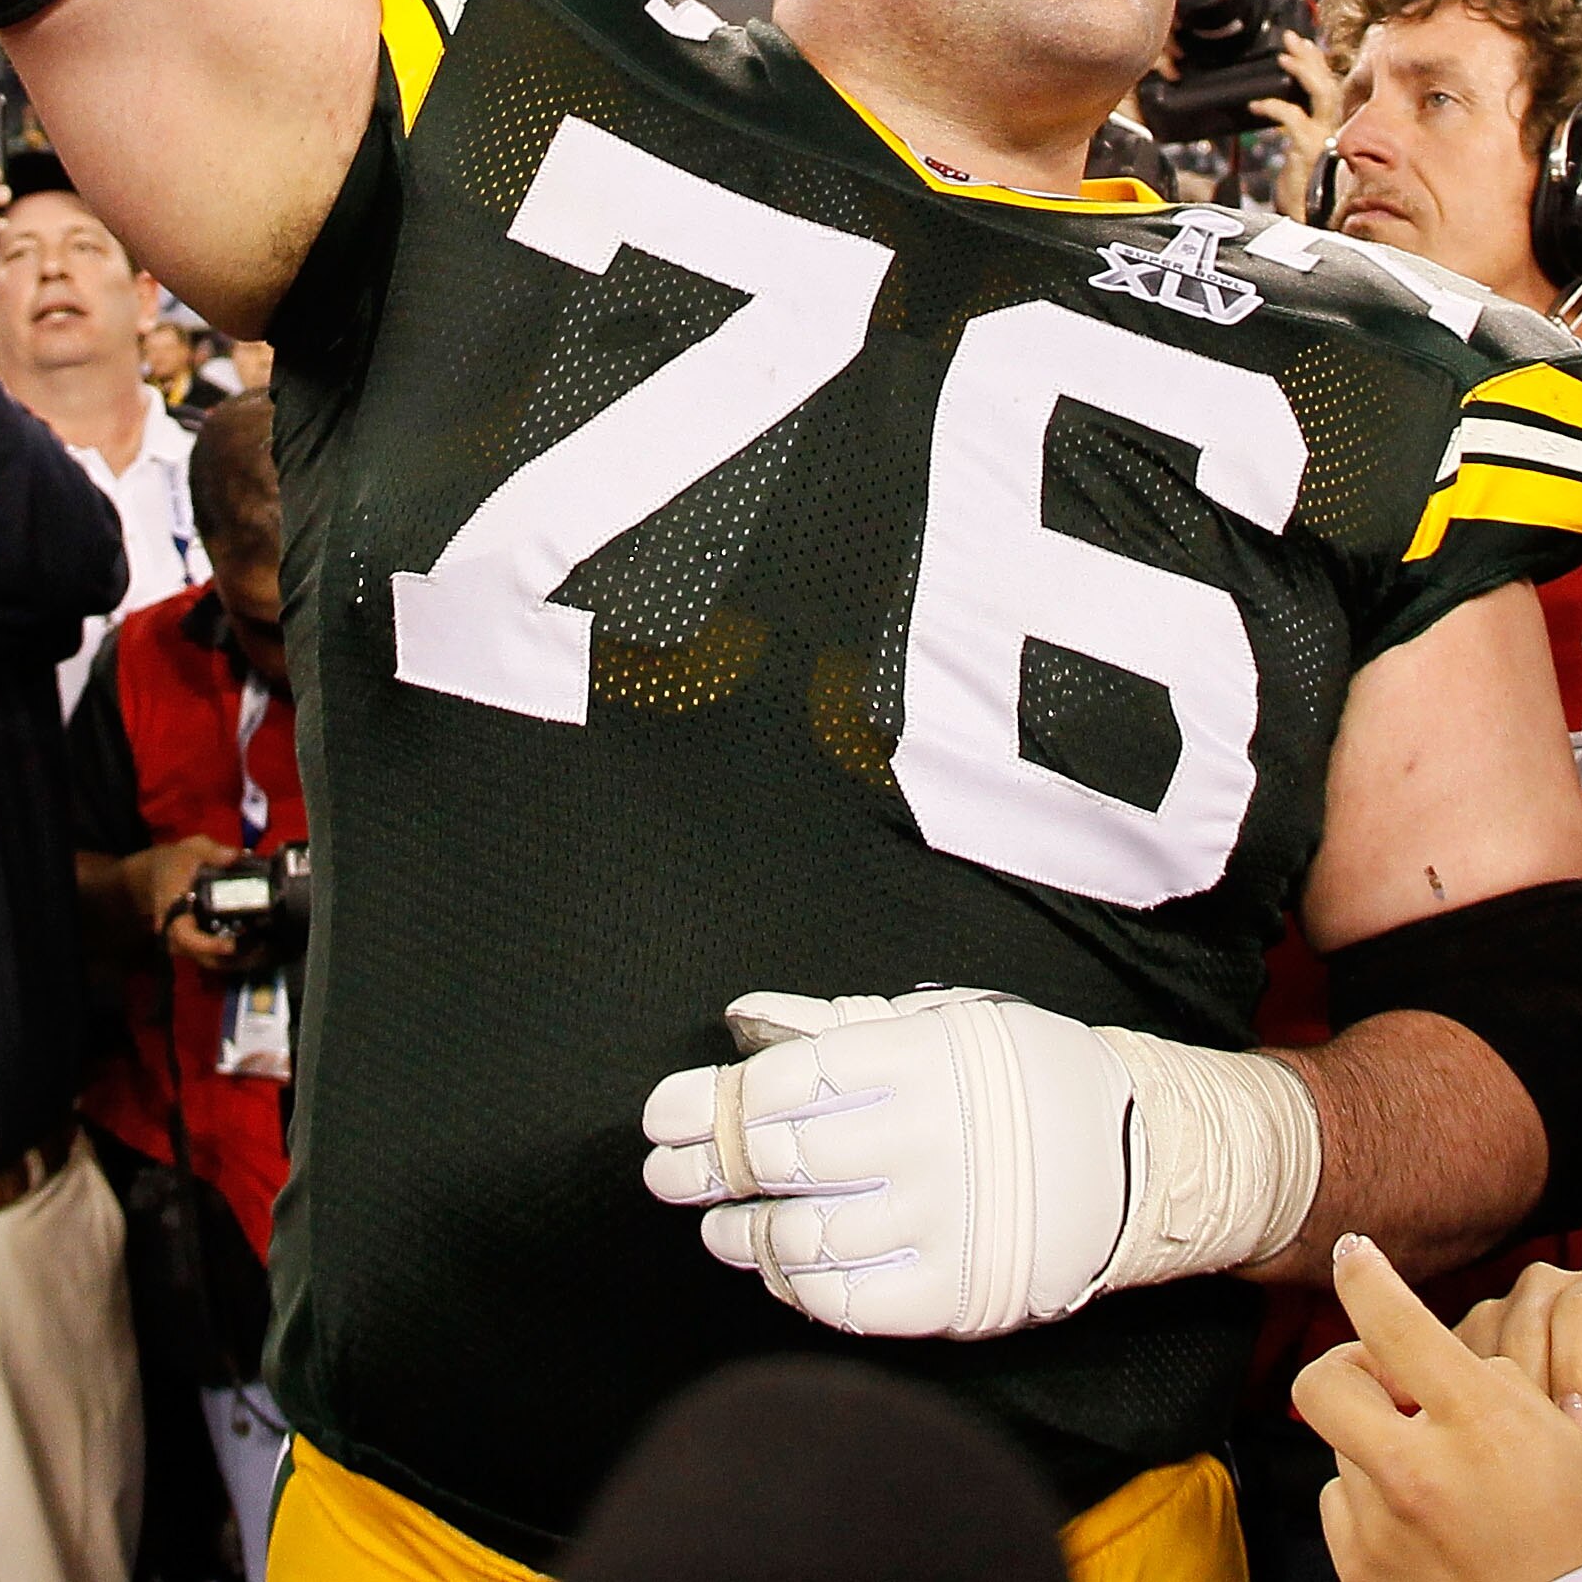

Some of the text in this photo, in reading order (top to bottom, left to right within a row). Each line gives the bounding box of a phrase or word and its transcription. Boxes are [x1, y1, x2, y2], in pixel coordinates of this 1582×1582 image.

[1088, 247, 1264, 325] XLV
[1123, 247, 1244, 290] SUPER BOWL
[393, 113, 1311, 910] 76
